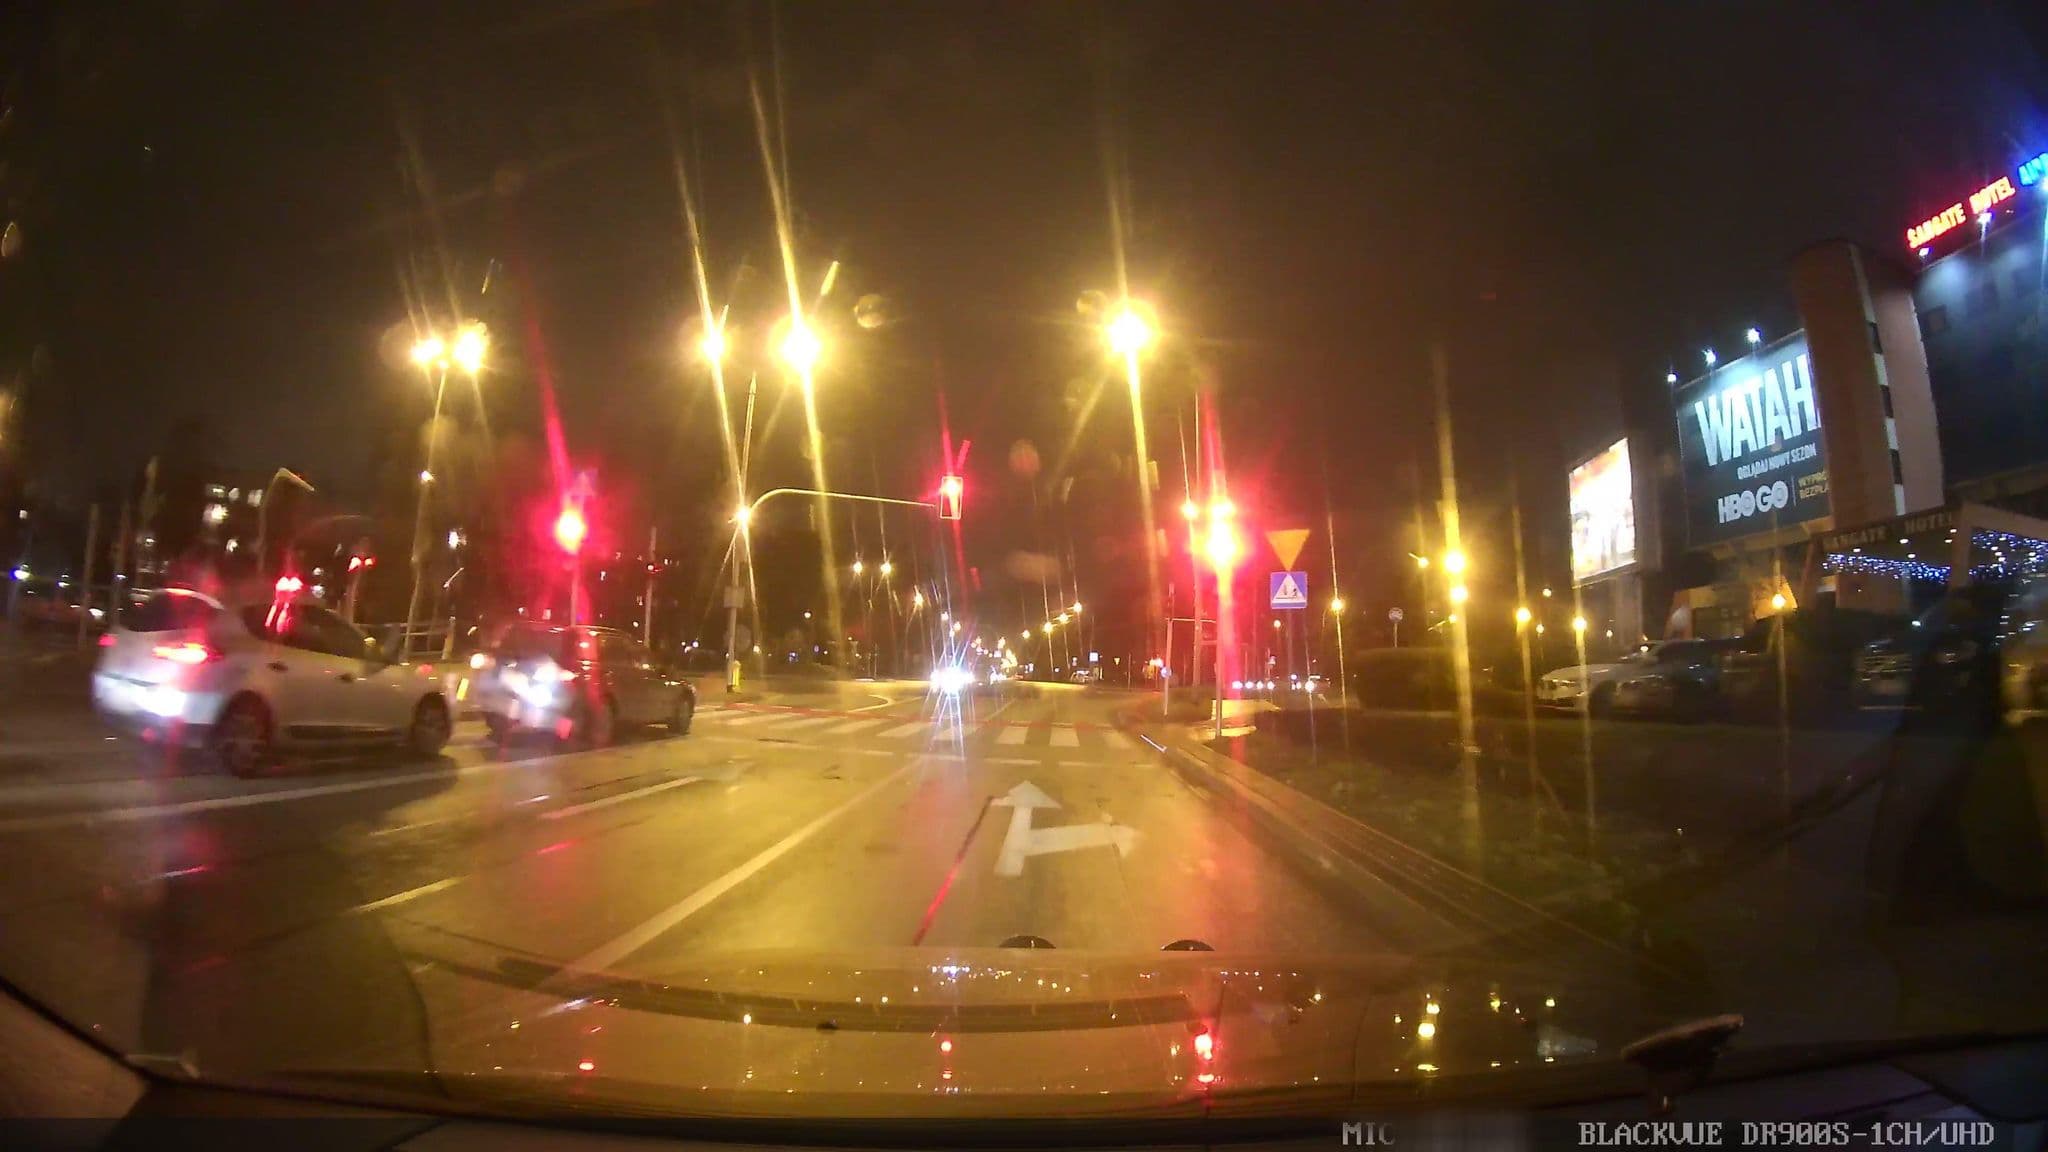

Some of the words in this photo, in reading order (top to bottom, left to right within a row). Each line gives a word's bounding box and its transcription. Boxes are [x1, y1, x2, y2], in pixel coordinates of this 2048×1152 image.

[1969, 176, 2015, 214] HOTEL
[1695, 354, 1821, 466] WATAH
[1791, 442, 1817, 463] SEZON
[1718, 490, 1755, 523] HBO
[1756, 480, 1788, 512] GO
